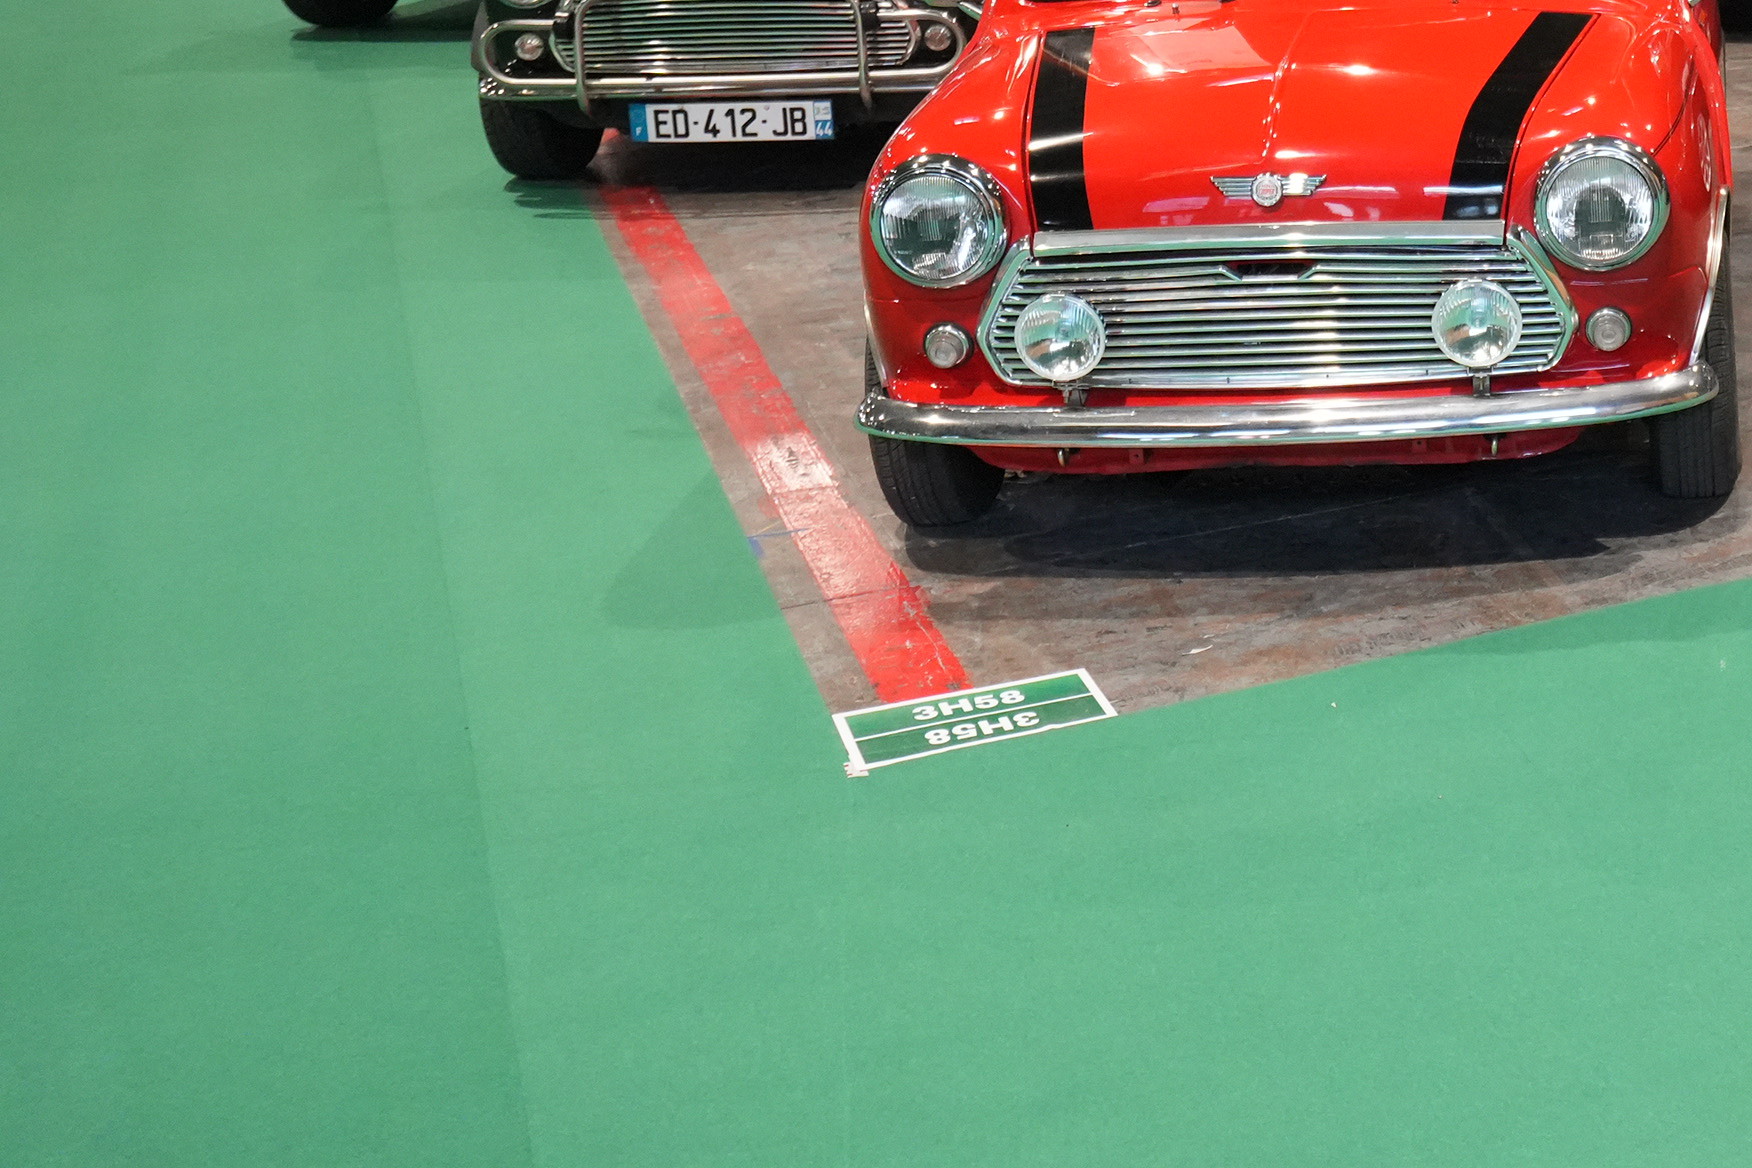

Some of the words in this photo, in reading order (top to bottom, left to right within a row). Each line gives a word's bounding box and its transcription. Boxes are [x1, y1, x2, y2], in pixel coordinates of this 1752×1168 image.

[653, 106, 807, 139] ED-412-JB
[816, 120, 832, 137] 44
[911, 689, 1026, 721] 3H58
[924, 711, 1040, 745] 3H58
